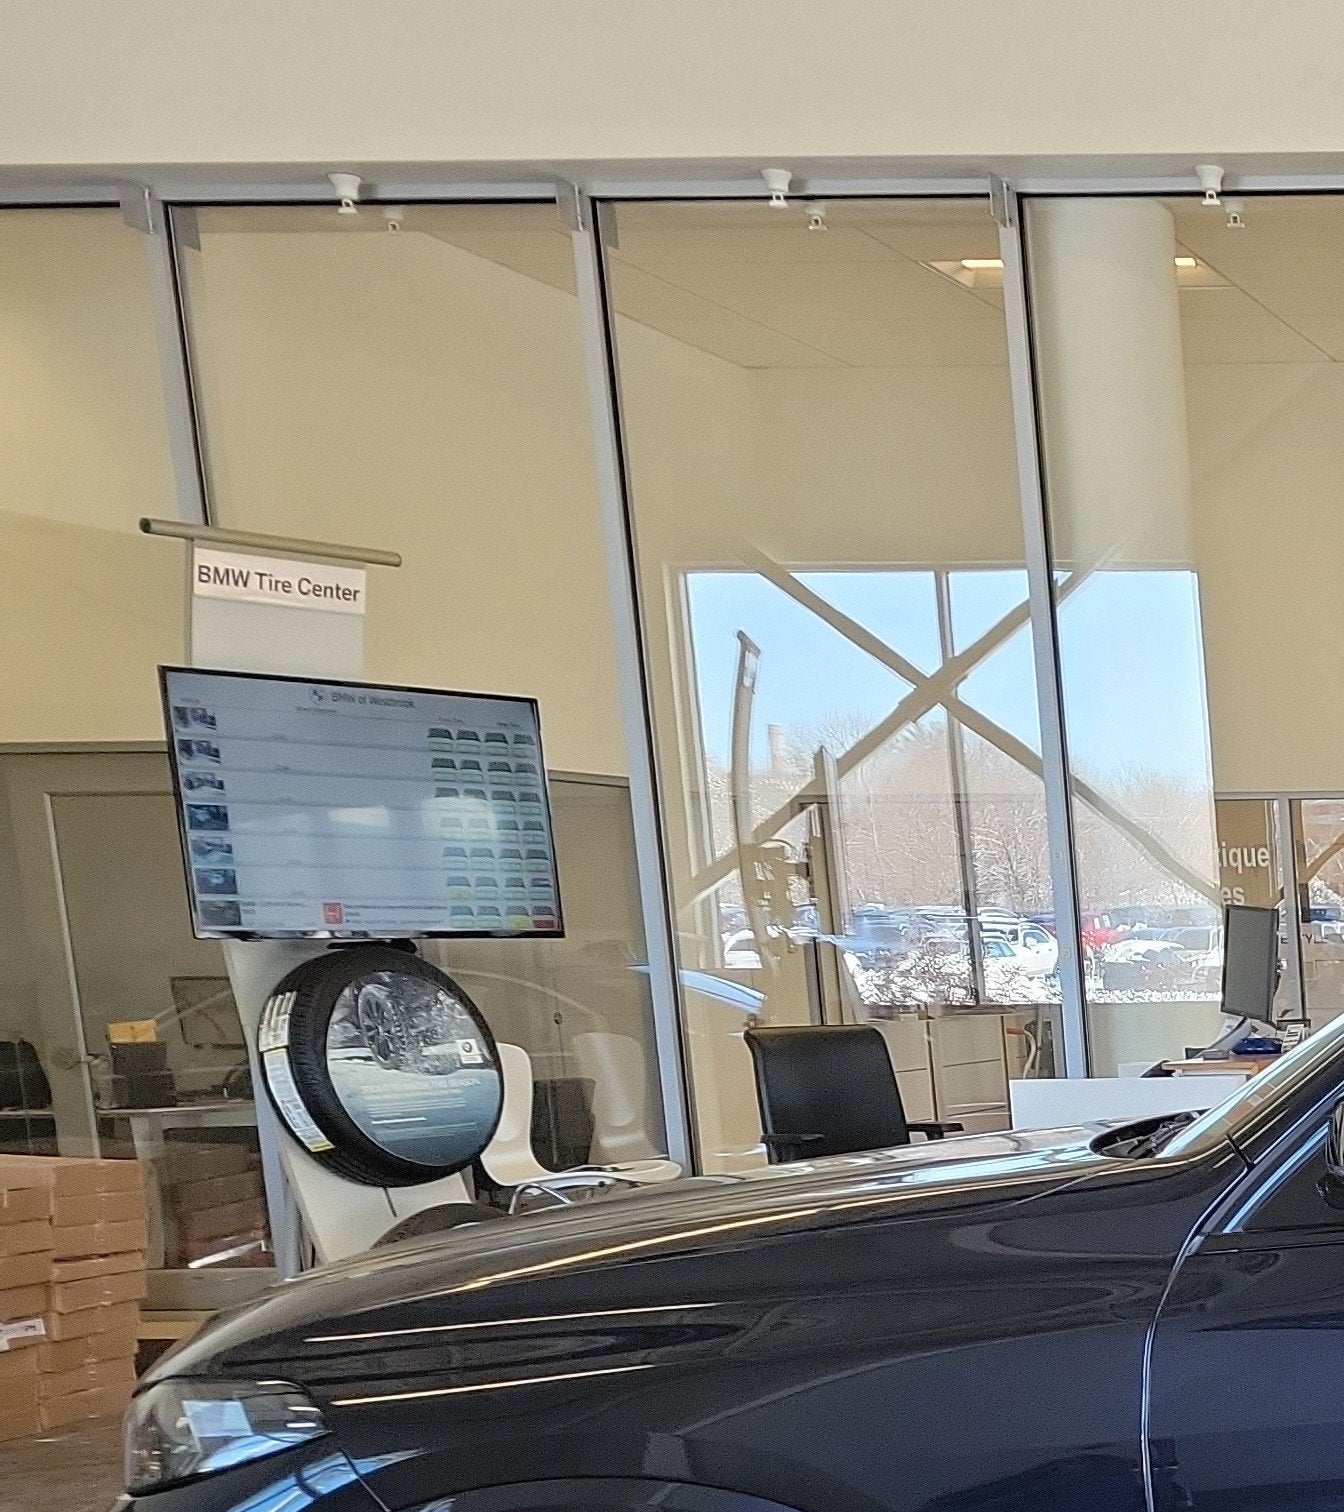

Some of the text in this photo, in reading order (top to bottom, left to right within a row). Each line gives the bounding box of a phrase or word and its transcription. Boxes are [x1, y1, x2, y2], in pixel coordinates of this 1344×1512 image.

[197, 564, 361, 602] BMW Tire Center
